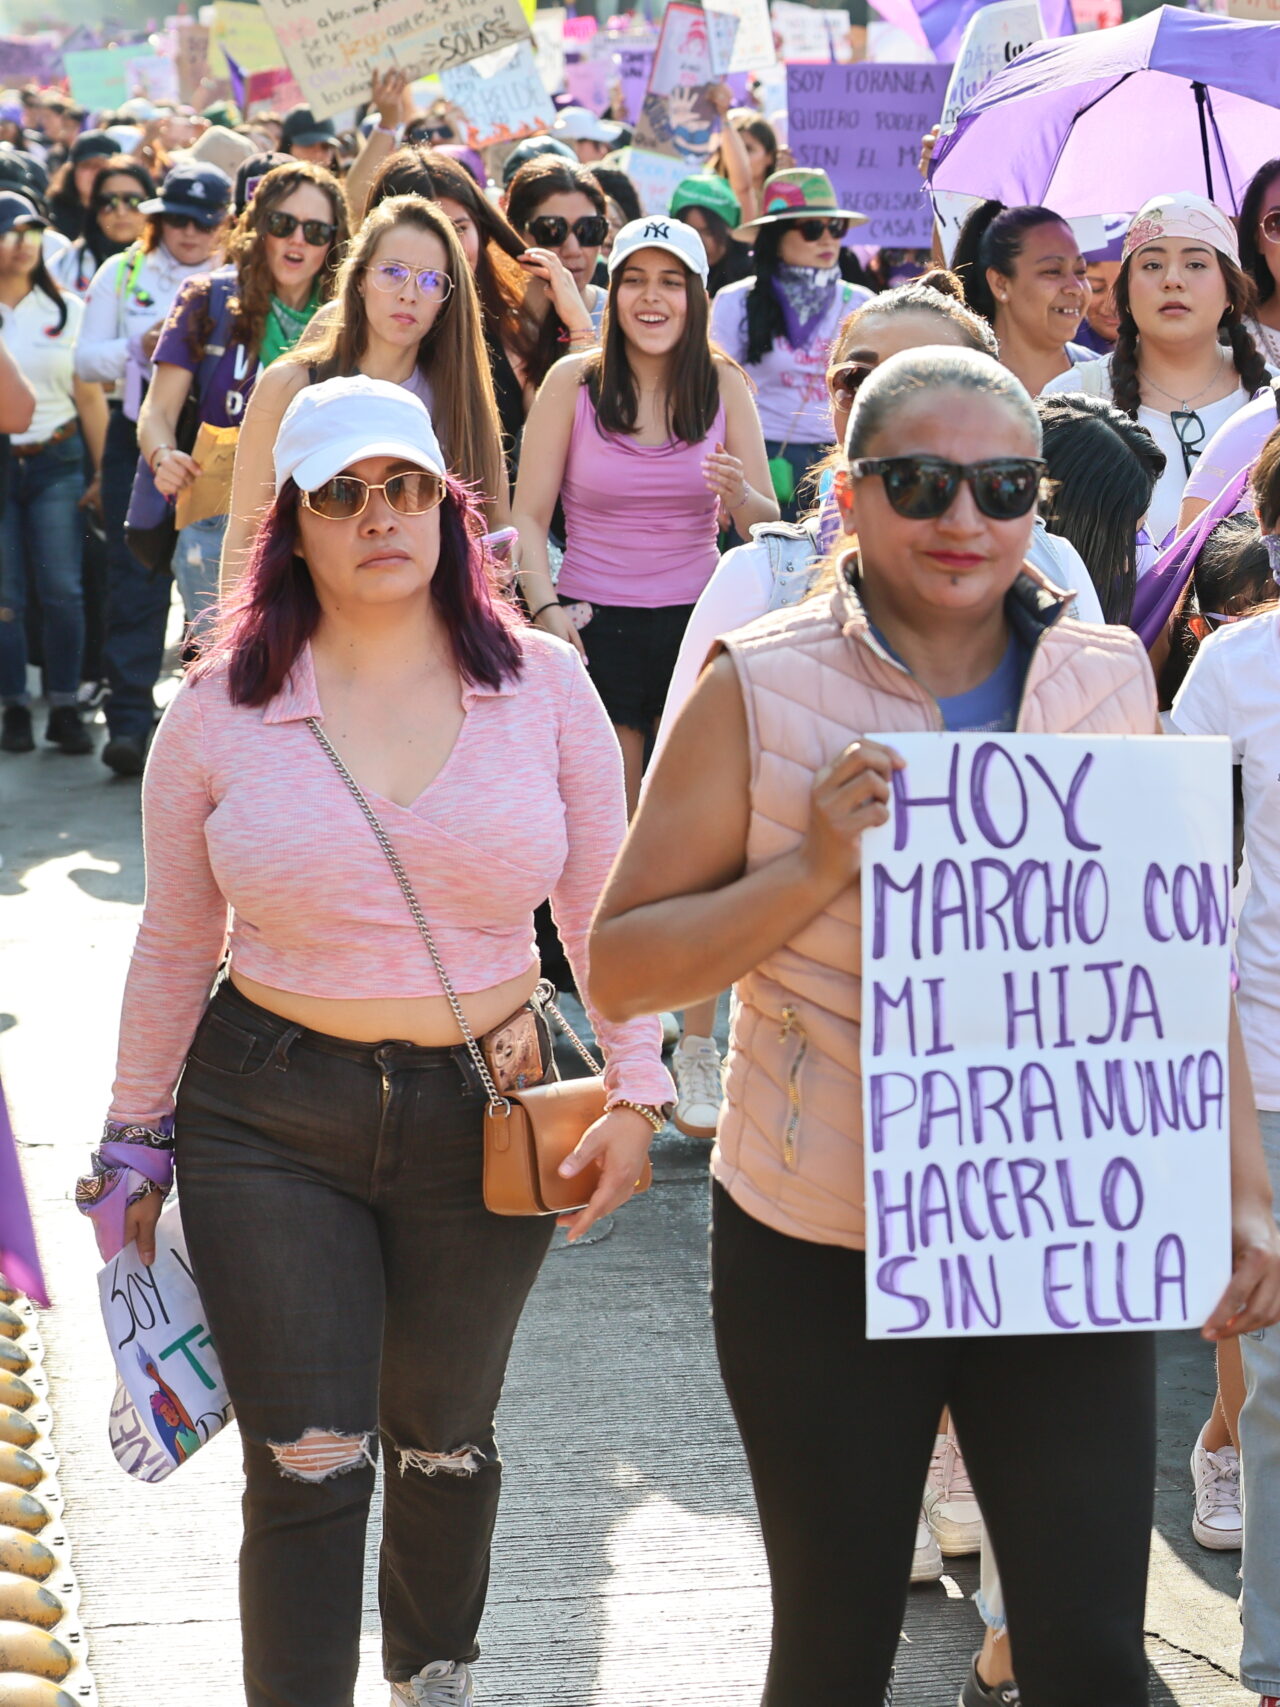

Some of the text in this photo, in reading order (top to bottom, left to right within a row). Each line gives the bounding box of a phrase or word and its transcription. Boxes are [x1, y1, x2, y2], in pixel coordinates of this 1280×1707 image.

[440, 19, 500, 61] SOLAS
[790, 70, 824, 93] SOY
[790, 108, 860, 131] QUIERO
[876, 111, 929, 132] PODER
[801, 146, 839, 167] SIN
[857, 148, 879, 168] EL
[870, 218, 916, 238] CASA
[892, 741, 1102, 851] HOY
[873, 858, 1229, 960] MARCHO CON
[873, 961, 1164, 1056] MI HIJA
[870, 1050, 1224, 1153] PARA NUNCA
[873, 1156, 1144, 1258] HACERLO
[111, 1258, 170, 1350] SOY
[876, 1233, 1188, 1334] SIN ELLA
